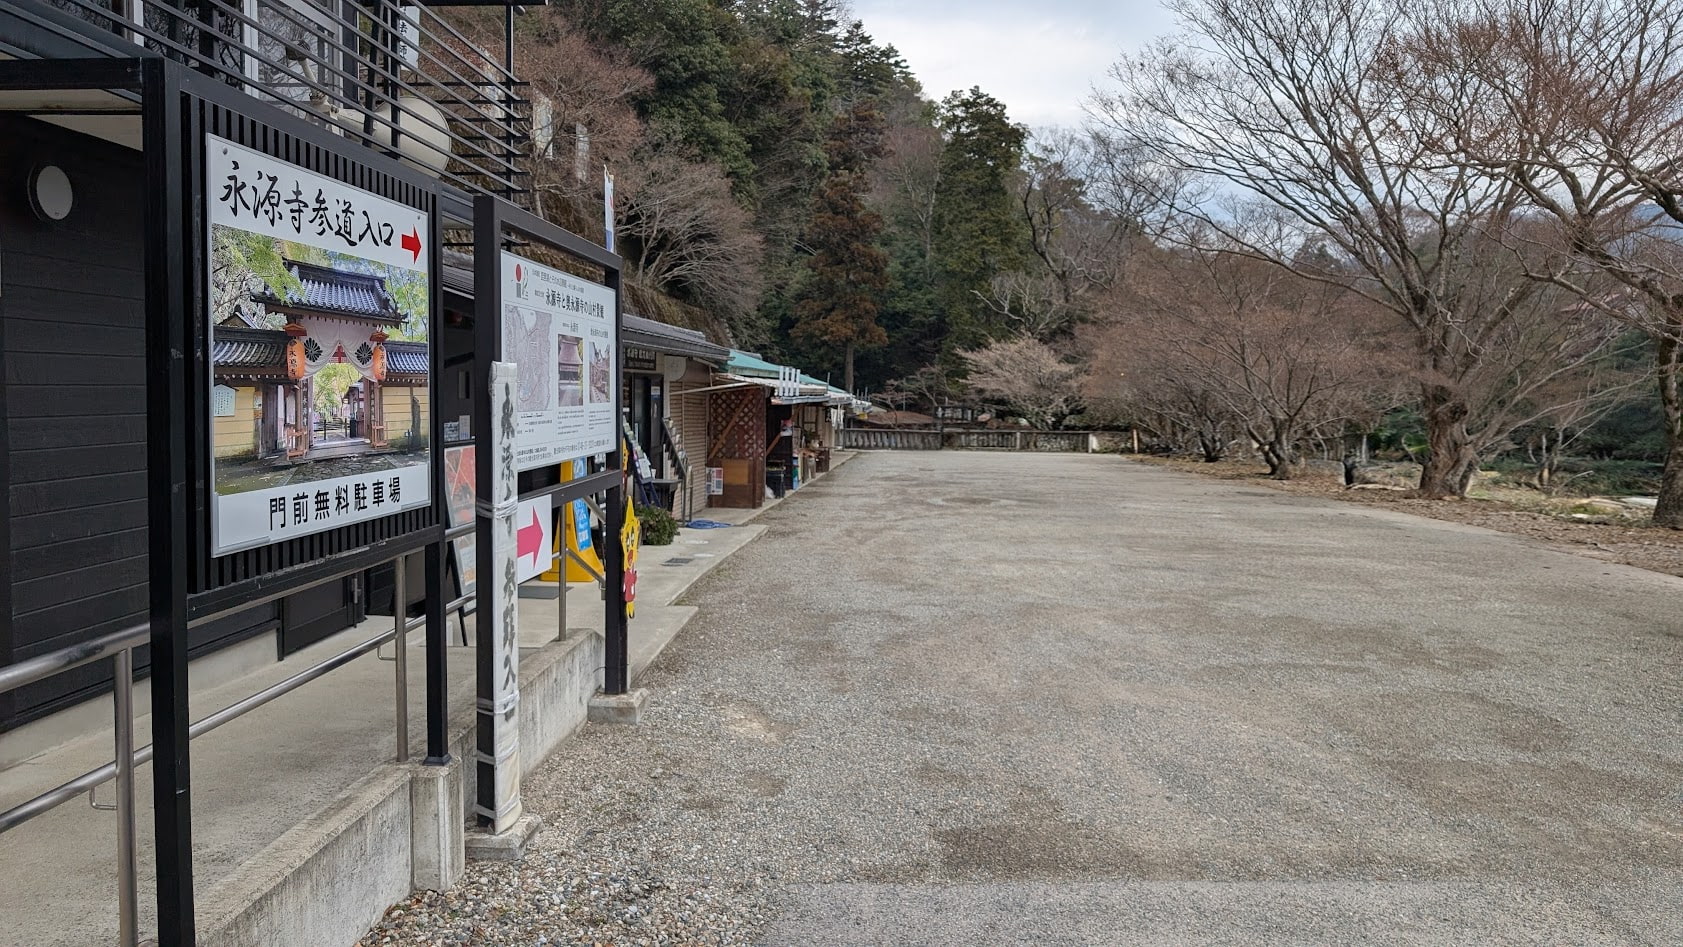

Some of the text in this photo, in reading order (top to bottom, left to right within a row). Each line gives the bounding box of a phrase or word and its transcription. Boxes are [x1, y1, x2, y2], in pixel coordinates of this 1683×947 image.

[219, 160, 394, 249] 永源寺参道入口
[268, 476, 401, 531] 門前無料駐車場
